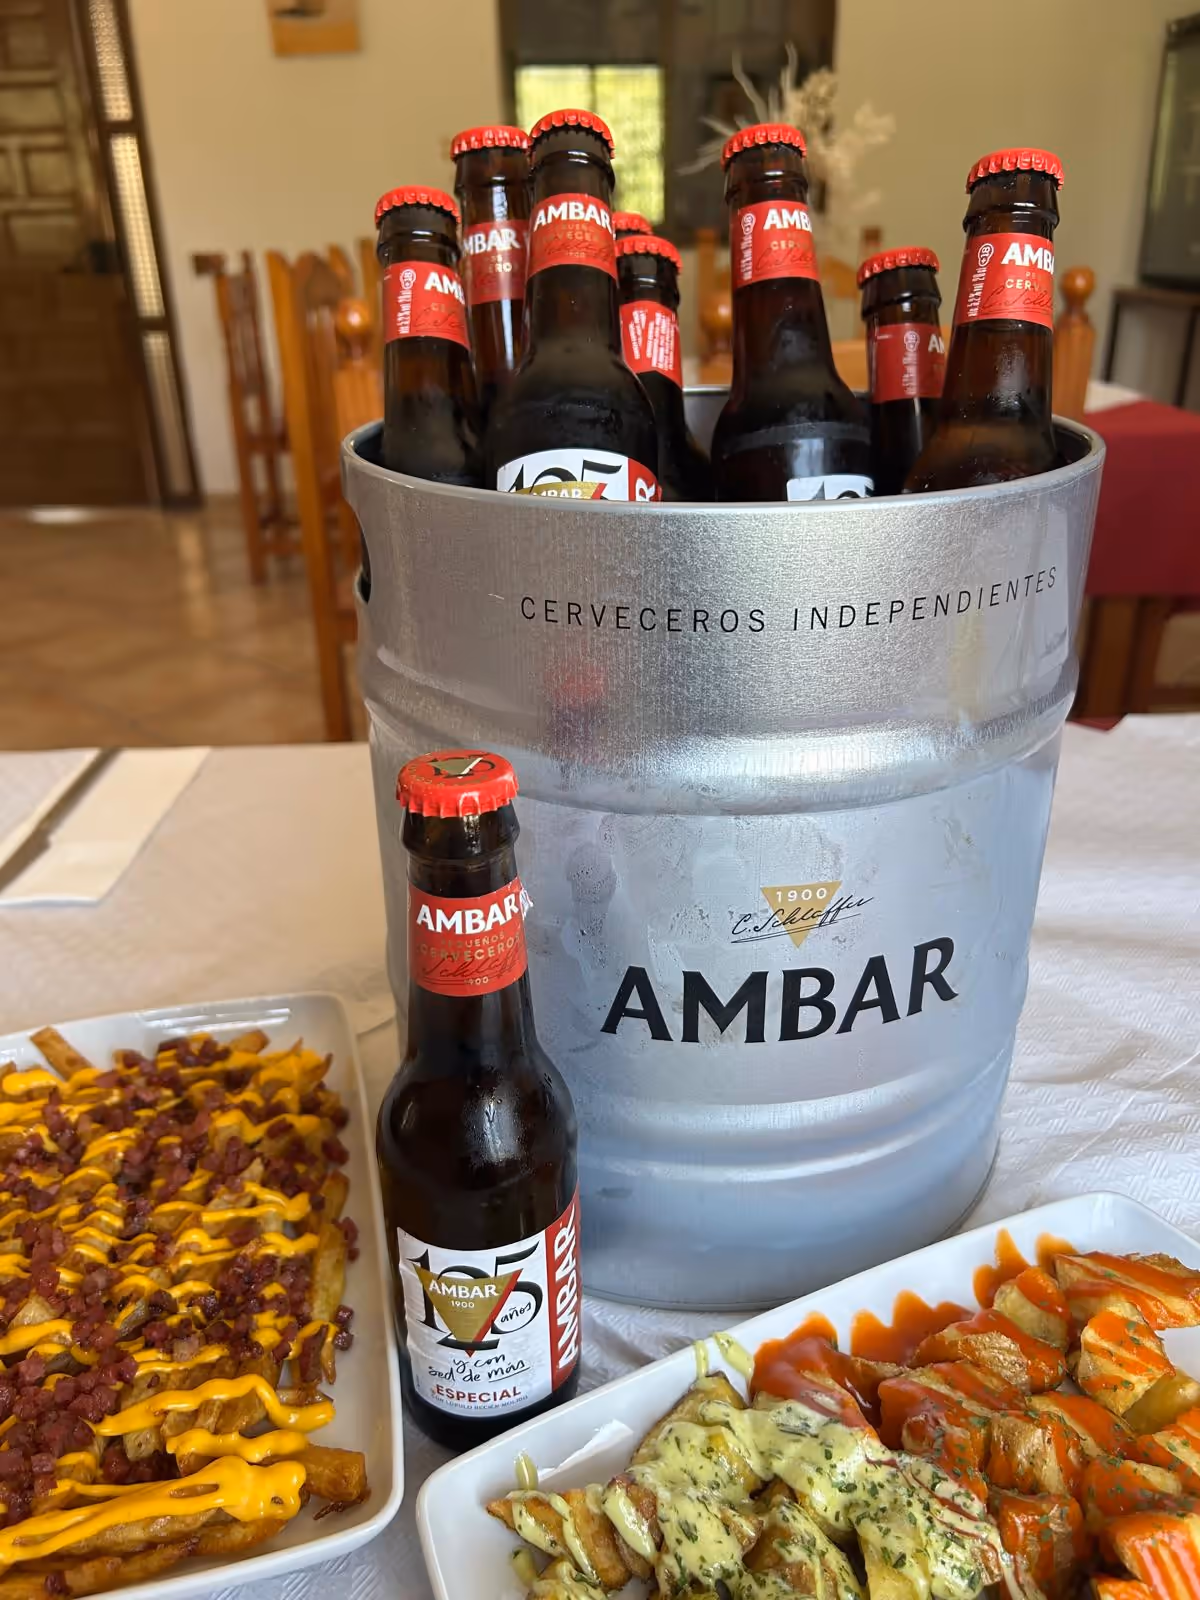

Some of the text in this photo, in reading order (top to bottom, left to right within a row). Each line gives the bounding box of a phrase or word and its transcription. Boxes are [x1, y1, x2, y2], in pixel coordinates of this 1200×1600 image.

[533, 202, 616, 240] AMBAR
[463, 228, 521, 255] MBAR
[1001, 242, 1054, 275] AMB
[424, 271, 465, 305] AM
[521, 567, 1057, 633] CERVECEROS INDEPENDIENTES
[776, 887, 828, 903] 1900
[416, 893, 519, 935] AMBAR
[600, 937, 959, 1043] AMBAR
[428, 1281, 500, 1299] AMBAR
[555, 1203, 578, 1370] AMBAR
[451, 1300, 475, 1309] 1900
[500, 1301, 532, 1324] años
[428, 1366, 456, 1382] sed
[462, 1368, 480, 1382] de
[487, 1359, 526, 1380] más
[453, 1353, 506, 1374] y con
[435, 1385, 522, 1403] ESPECIAL
